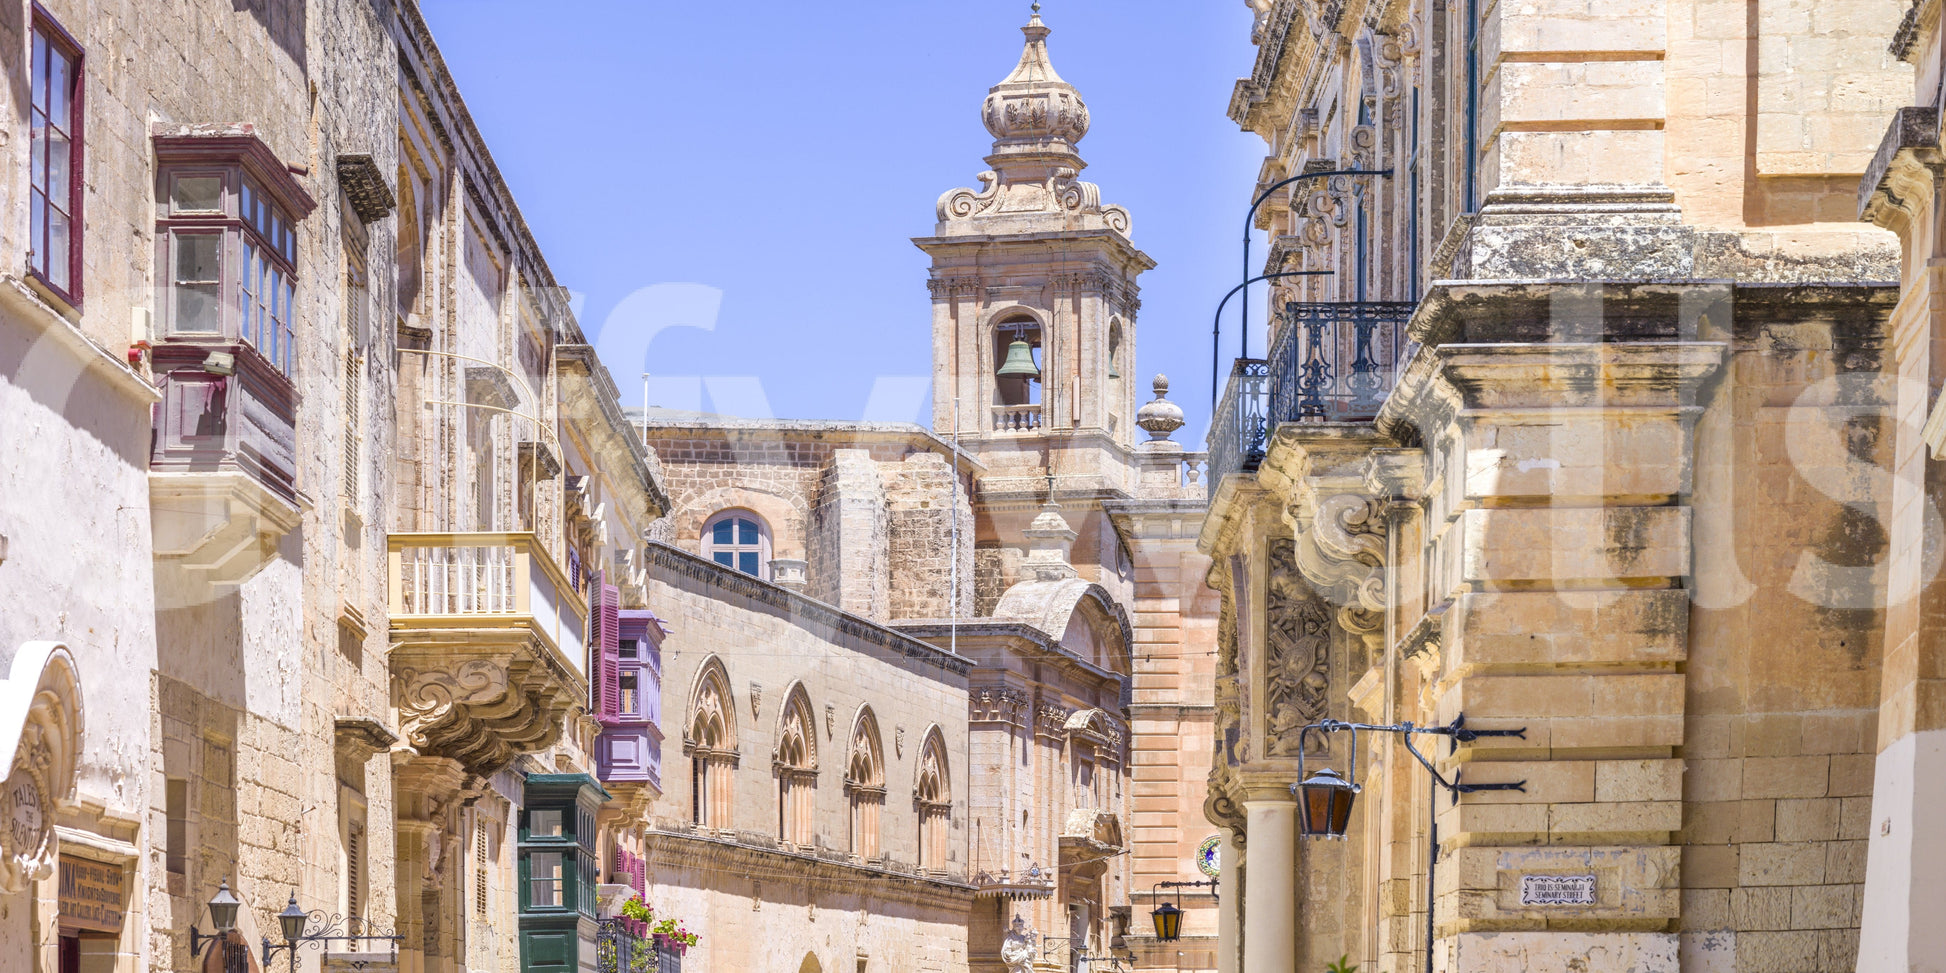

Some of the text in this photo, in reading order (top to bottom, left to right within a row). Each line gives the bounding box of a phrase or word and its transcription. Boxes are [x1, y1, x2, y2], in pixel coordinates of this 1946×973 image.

[13, 784, 36, 808] TALES
[1535, 891, 1583, 899] SEMINARY STREET
